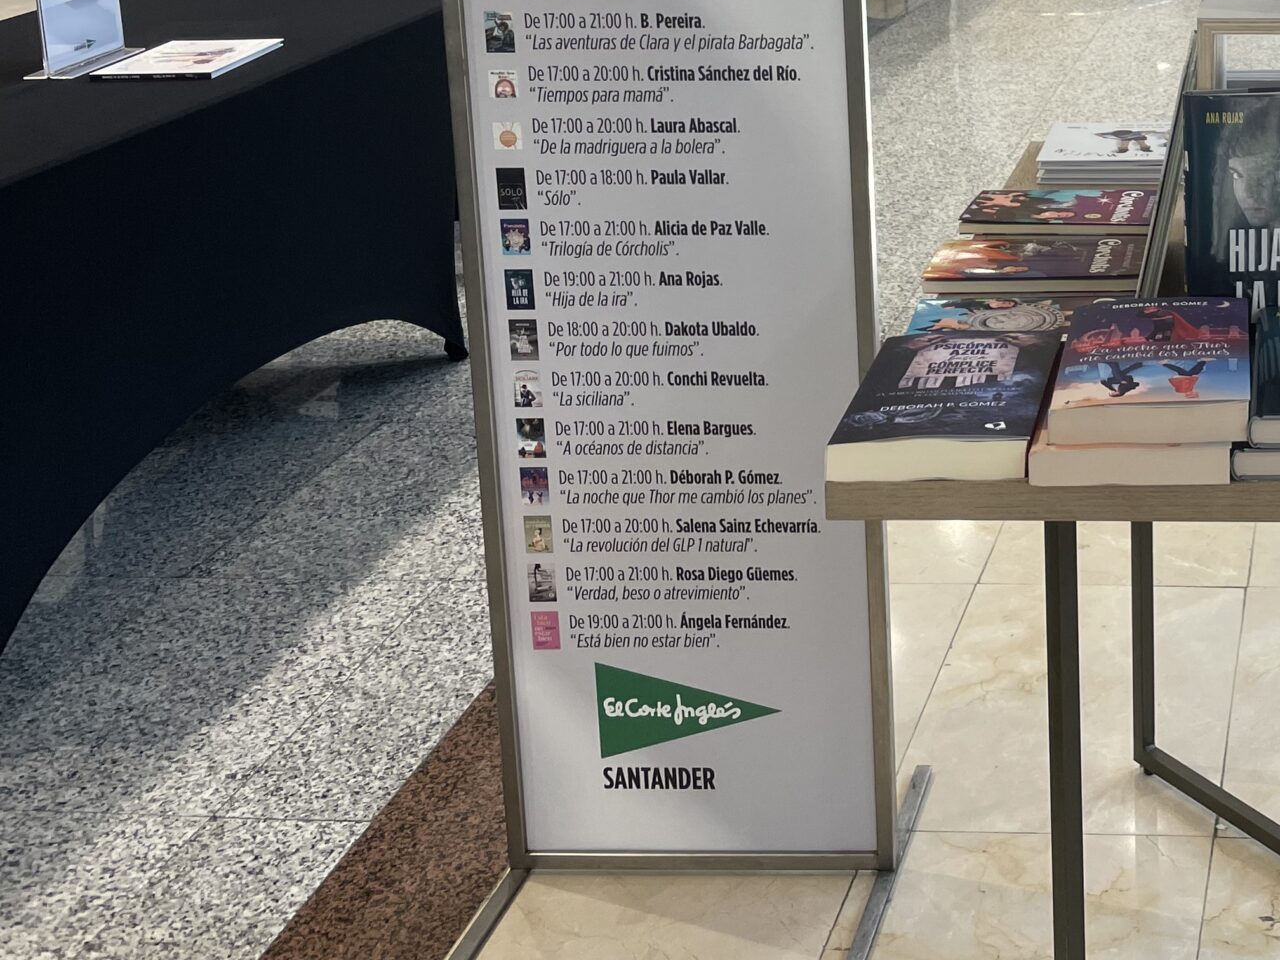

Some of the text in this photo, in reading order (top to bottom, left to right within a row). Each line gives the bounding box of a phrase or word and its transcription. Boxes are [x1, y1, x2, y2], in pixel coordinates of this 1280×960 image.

[528, 65, 800, 82] De 17:00 a 20:00 h. Cristina Sánchez del Río.
[1206, 111, 1244, 124] ANA ROJAS
[548, 321, 759, 337] De 18:00 a 20:00 h. Dakota Ubaldo.
[933, 341, 1009, 351] PSICÓPATA
[1117, 342, 1158, 354] noche
[1163, 343, 1188, 352] que
[1191, 341, 1231, 350] Thor
[1183, 348, 1230, 358] planes
[928, 359, 997, 369] CÓMPLICE
[926, 367, 993, 376] PERFECTA
[570, 615, 585, 630] De
[588, 615, 619, 630] 19:00
[622, 619, 630, 630] a
[633, 615, 663, 630] 21:00
[666, 615, 677, 629] h.
[680, 612, 722, 631] Ángela
[725, 614, 790, 630] Fernández.
[603, 694, 742, 725] El Corte Inglés
[603, 766, 716, 790] SANTANDER
